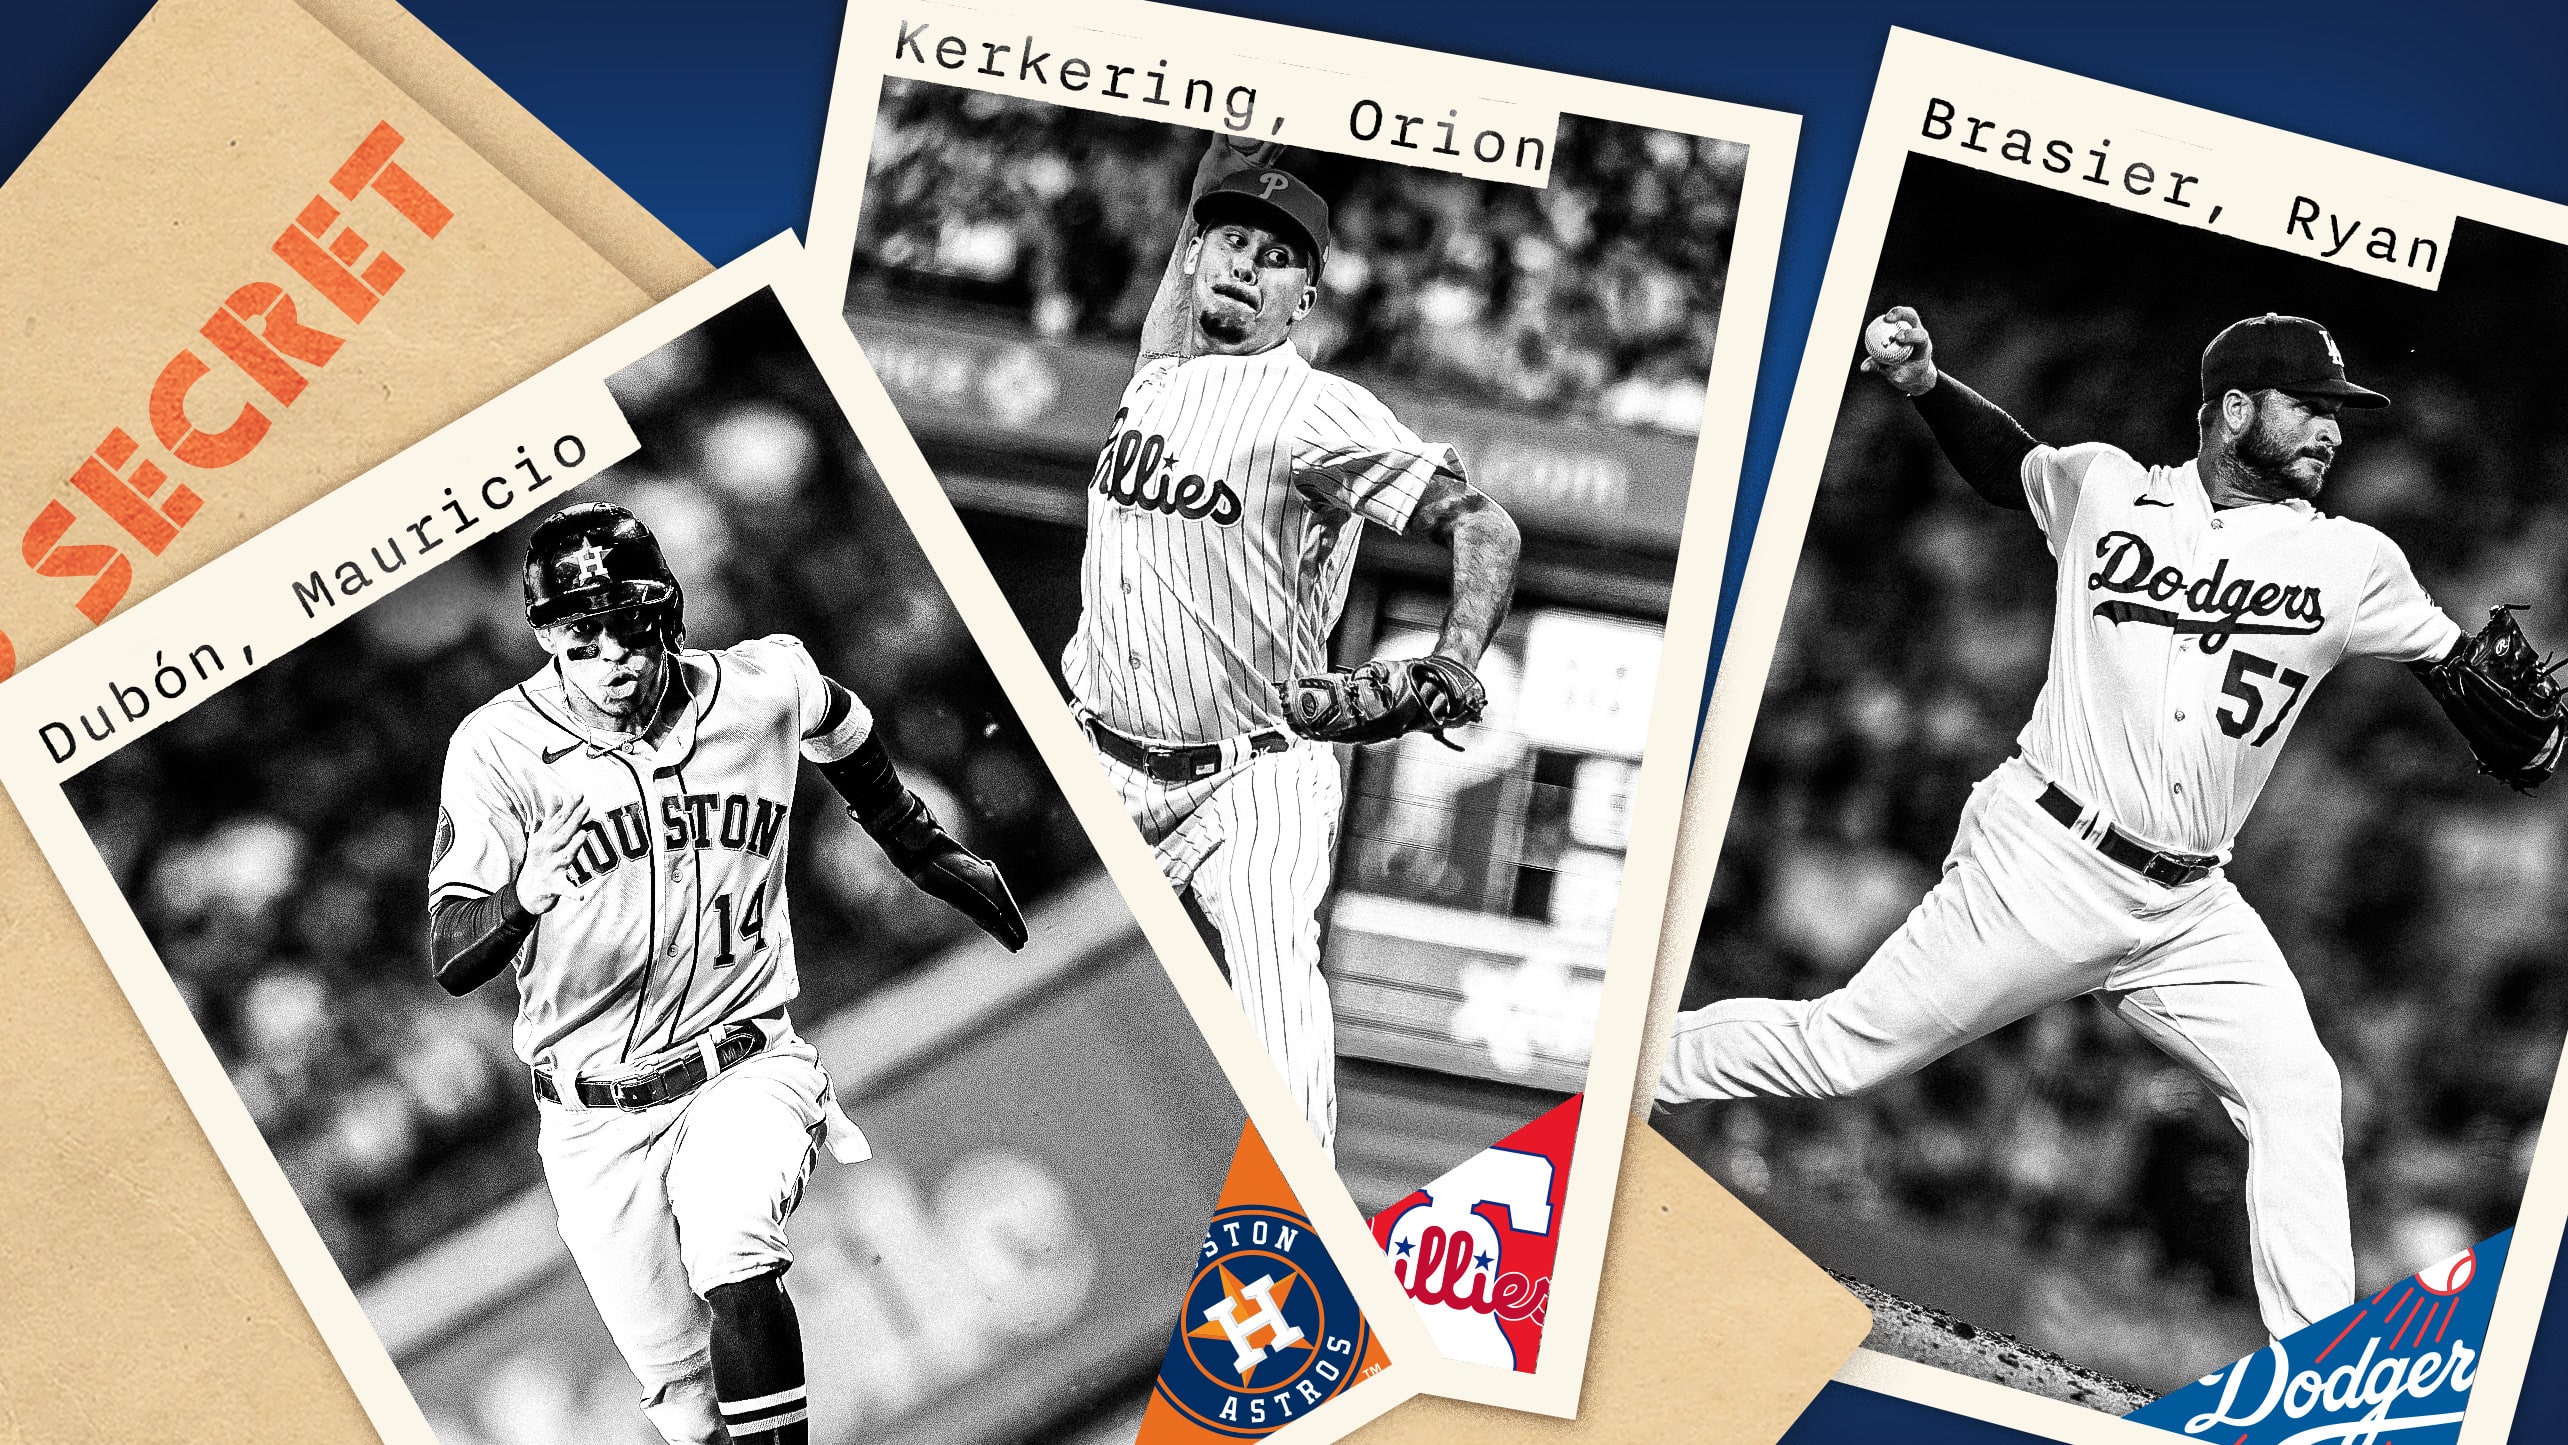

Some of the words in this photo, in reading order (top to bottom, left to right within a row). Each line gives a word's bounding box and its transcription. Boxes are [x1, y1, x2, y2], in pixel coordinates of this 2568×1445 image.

[1258, 172, 1289, 200] P
[2087, 530, 2324, 655] Dodgers
[2215, 648, 2310, 748] 57
[713, 879, 770, 970] 14
